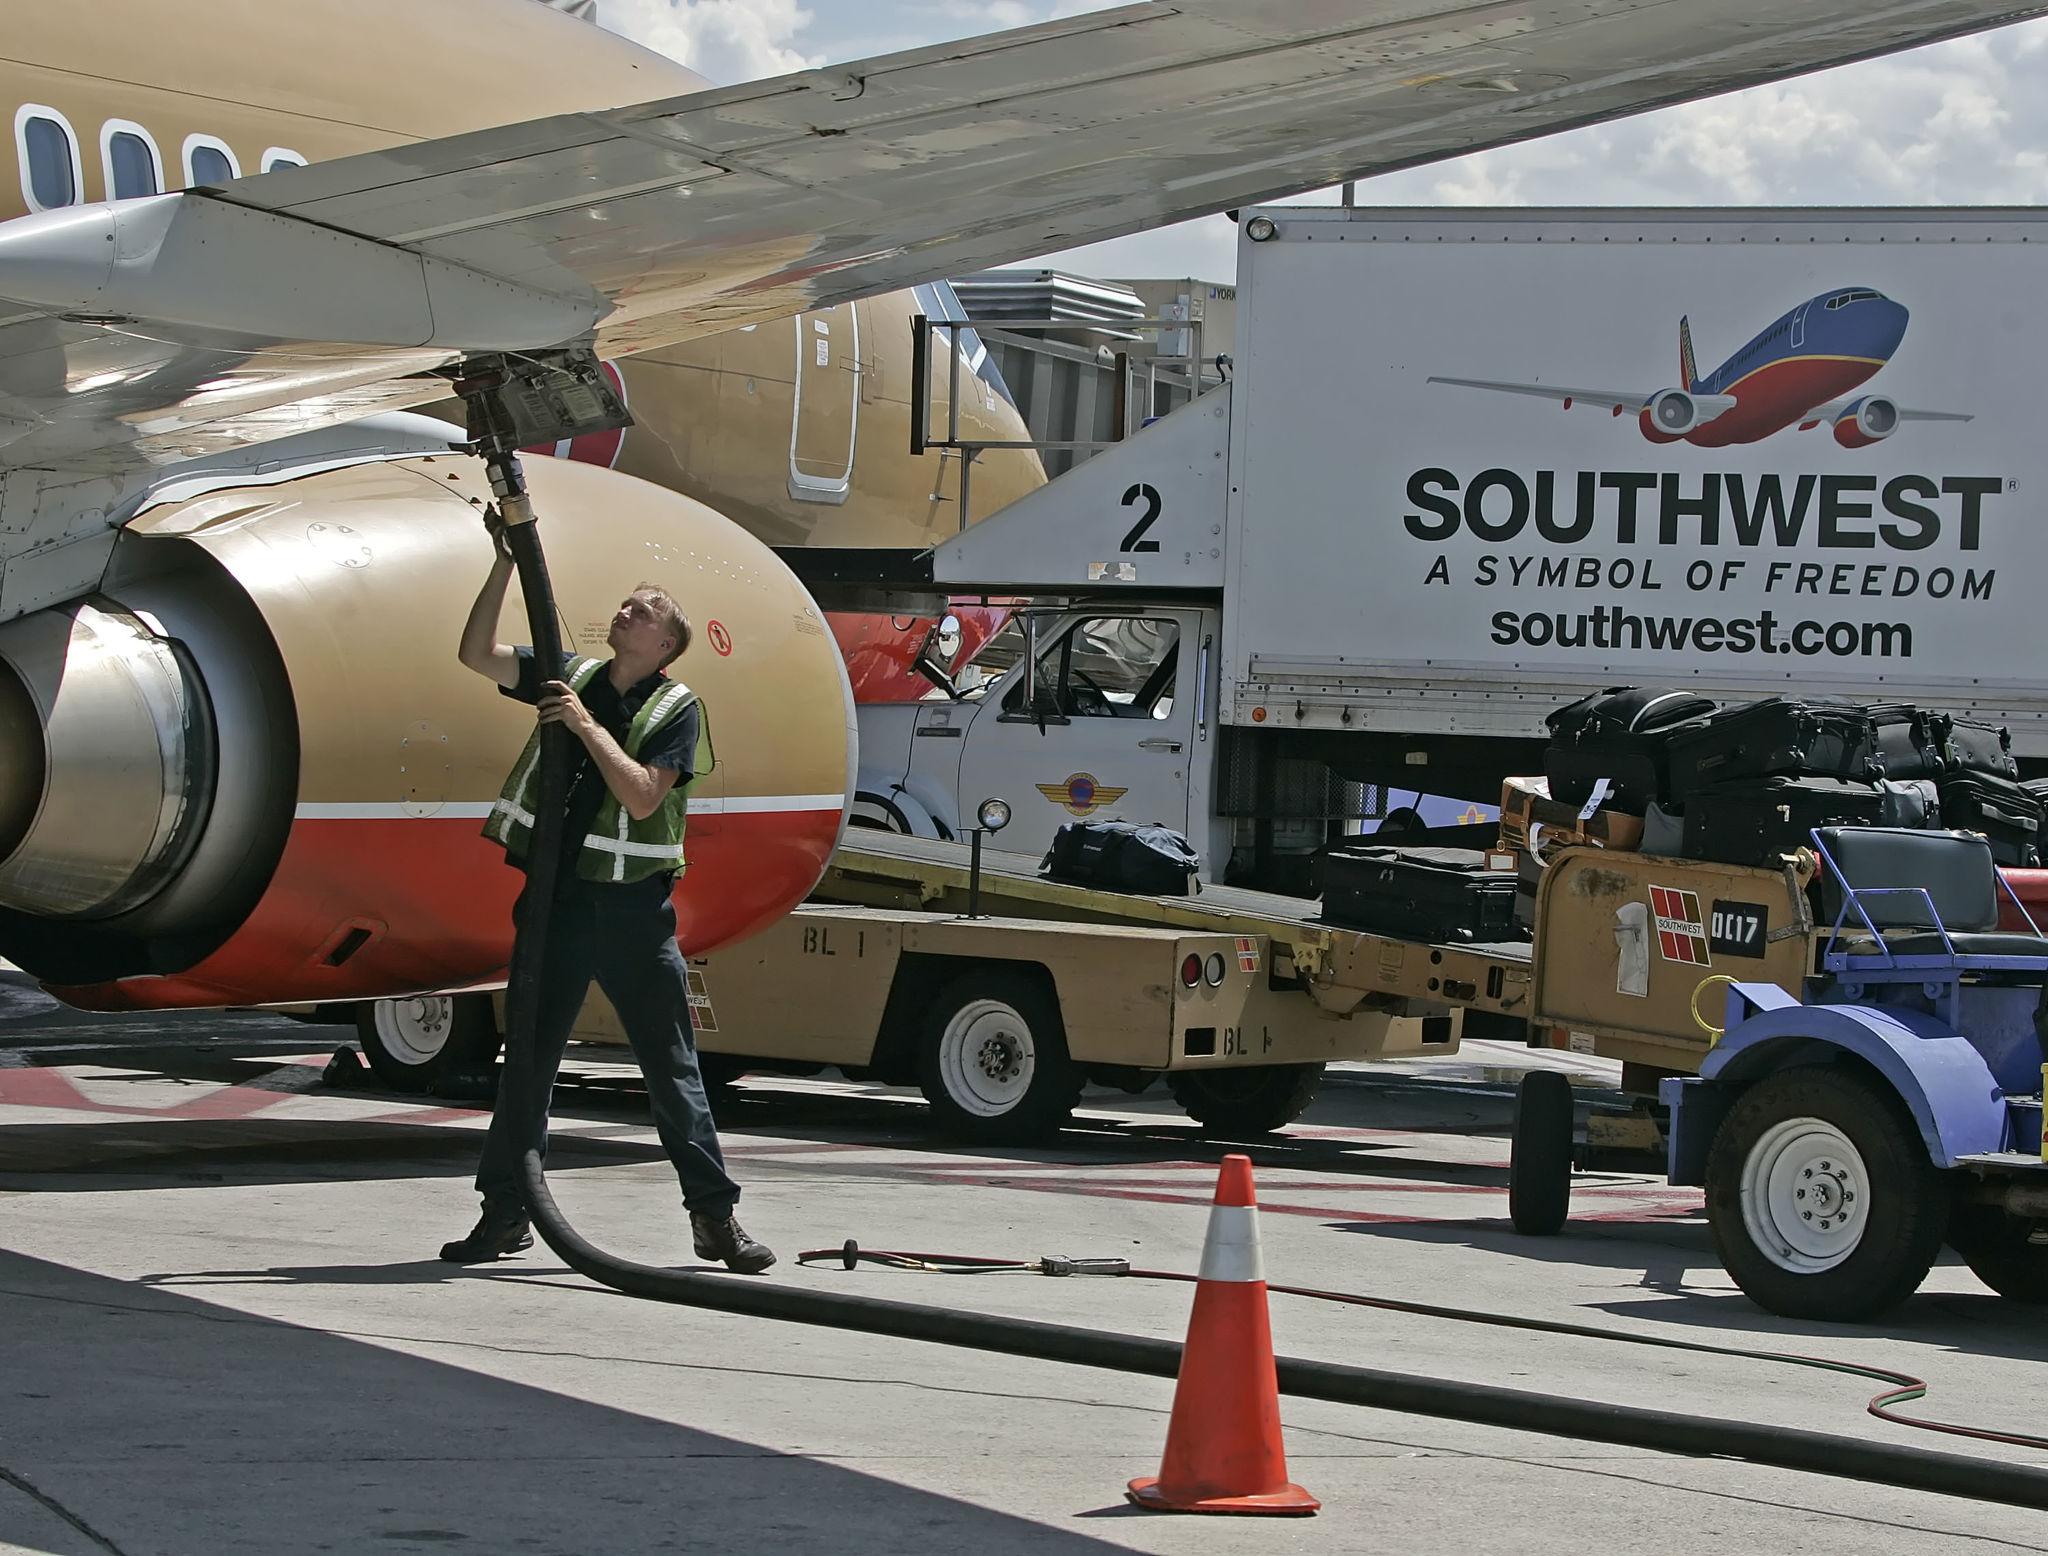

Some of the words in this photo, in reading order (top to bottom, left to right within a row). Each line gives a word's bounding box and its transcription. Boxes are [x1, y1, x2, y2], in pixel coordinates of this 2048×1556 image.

[1119, 483, 1162, 553] 2
[1403, 467, 2003, 551] SOUTHWEST
[1423, 554, 1450, 585] A
[1474, 555, 1662, 590] SYMBOL
[1686, 559, 1746, 592] OF
[1764, 561, 1996, 601] FREEDOM
[1490, 605, 1913, 658] southwest.com
[803, 926, 836, 956] BL
[858, 930, 865, 958] 1
[1658, 919, 1702, 934] SOUTHWEST
[1223, 1026, 1248, 1055] BL
